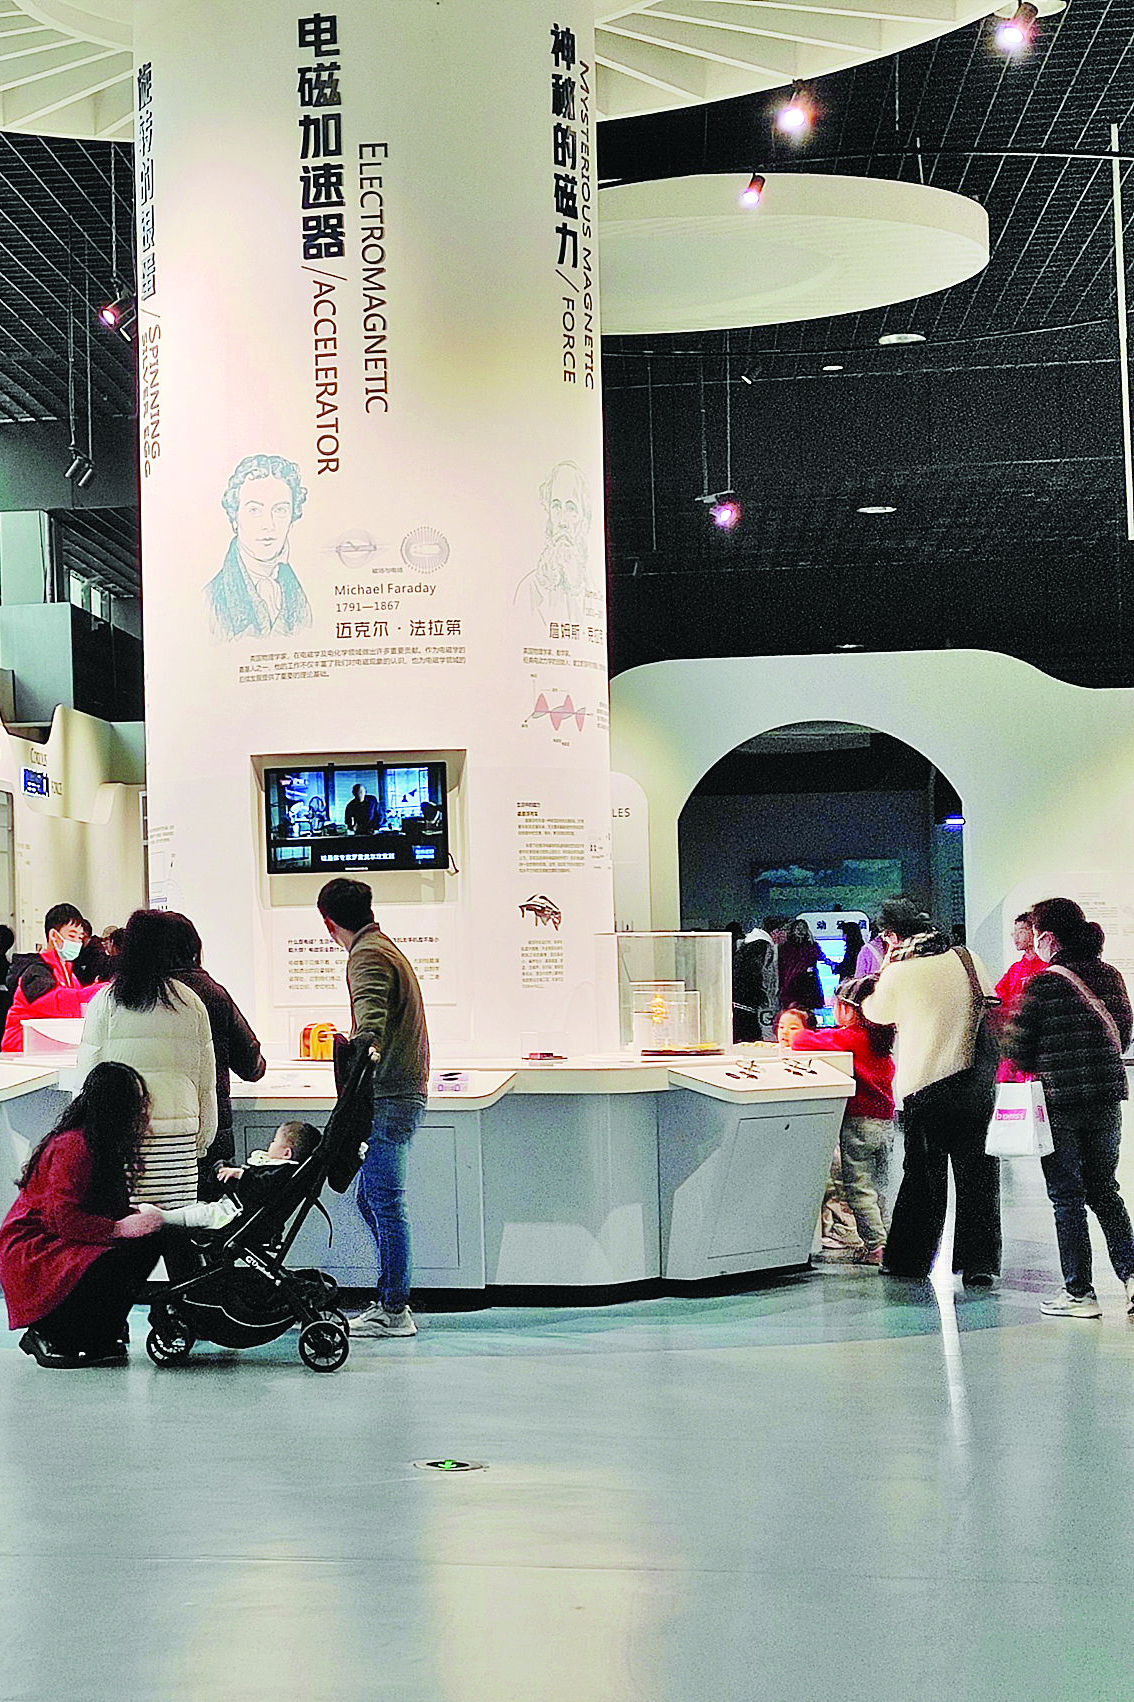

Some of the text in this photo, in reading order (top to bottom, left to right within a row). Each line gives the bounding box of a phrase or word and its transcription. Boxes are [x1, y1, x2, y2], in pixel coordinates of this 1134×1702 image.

[297, 12, 346, 261] 电磁加速器
[550, 22, 579, 269] 神秘的磁力
[579, 60, 594, 390] MYSTERIOUS MAGNETIC
[358, 142, 389, 414] ELECTROMAGNETIC
[334, 582, 437, 597] Michael Faraday
